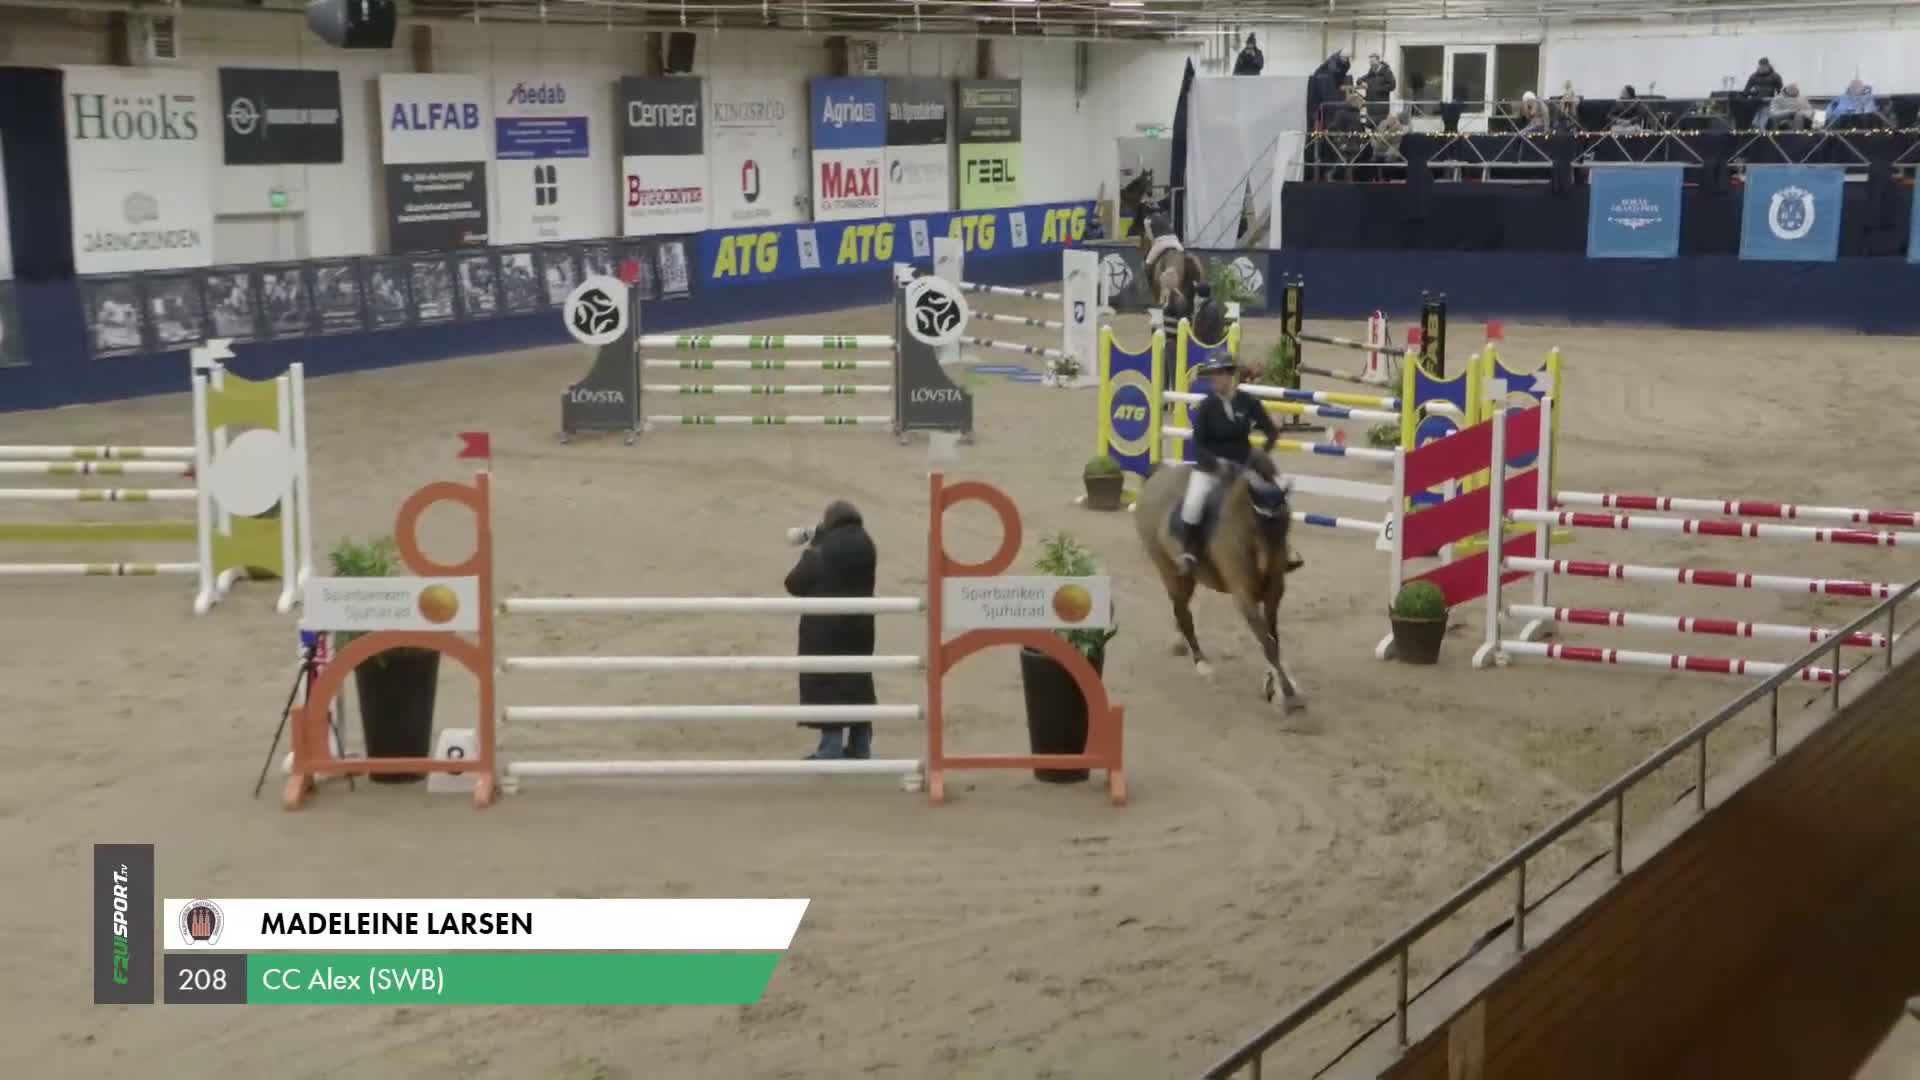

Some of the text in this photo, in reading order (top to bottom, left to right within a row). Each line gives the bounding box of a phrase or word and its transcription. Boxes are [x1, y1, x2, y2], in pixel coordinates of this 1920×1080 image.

[70, 93, 198, 140] Hööks
[391, 103, 480, 130] ALFAB
[947, 215, 996, 252] ATG
[1041, 207, 1086, 244] ATG
[712, 232, 779, 279] ATG
[837, 222, 895, 265] ATG
[570, 387, 624, 403] LÖVSTA
[911, 387, 961, 402] LÖVSTA
[1114, 405, 1146, 421] ATG
[961, 585, 1045, 602] Sparbanken
